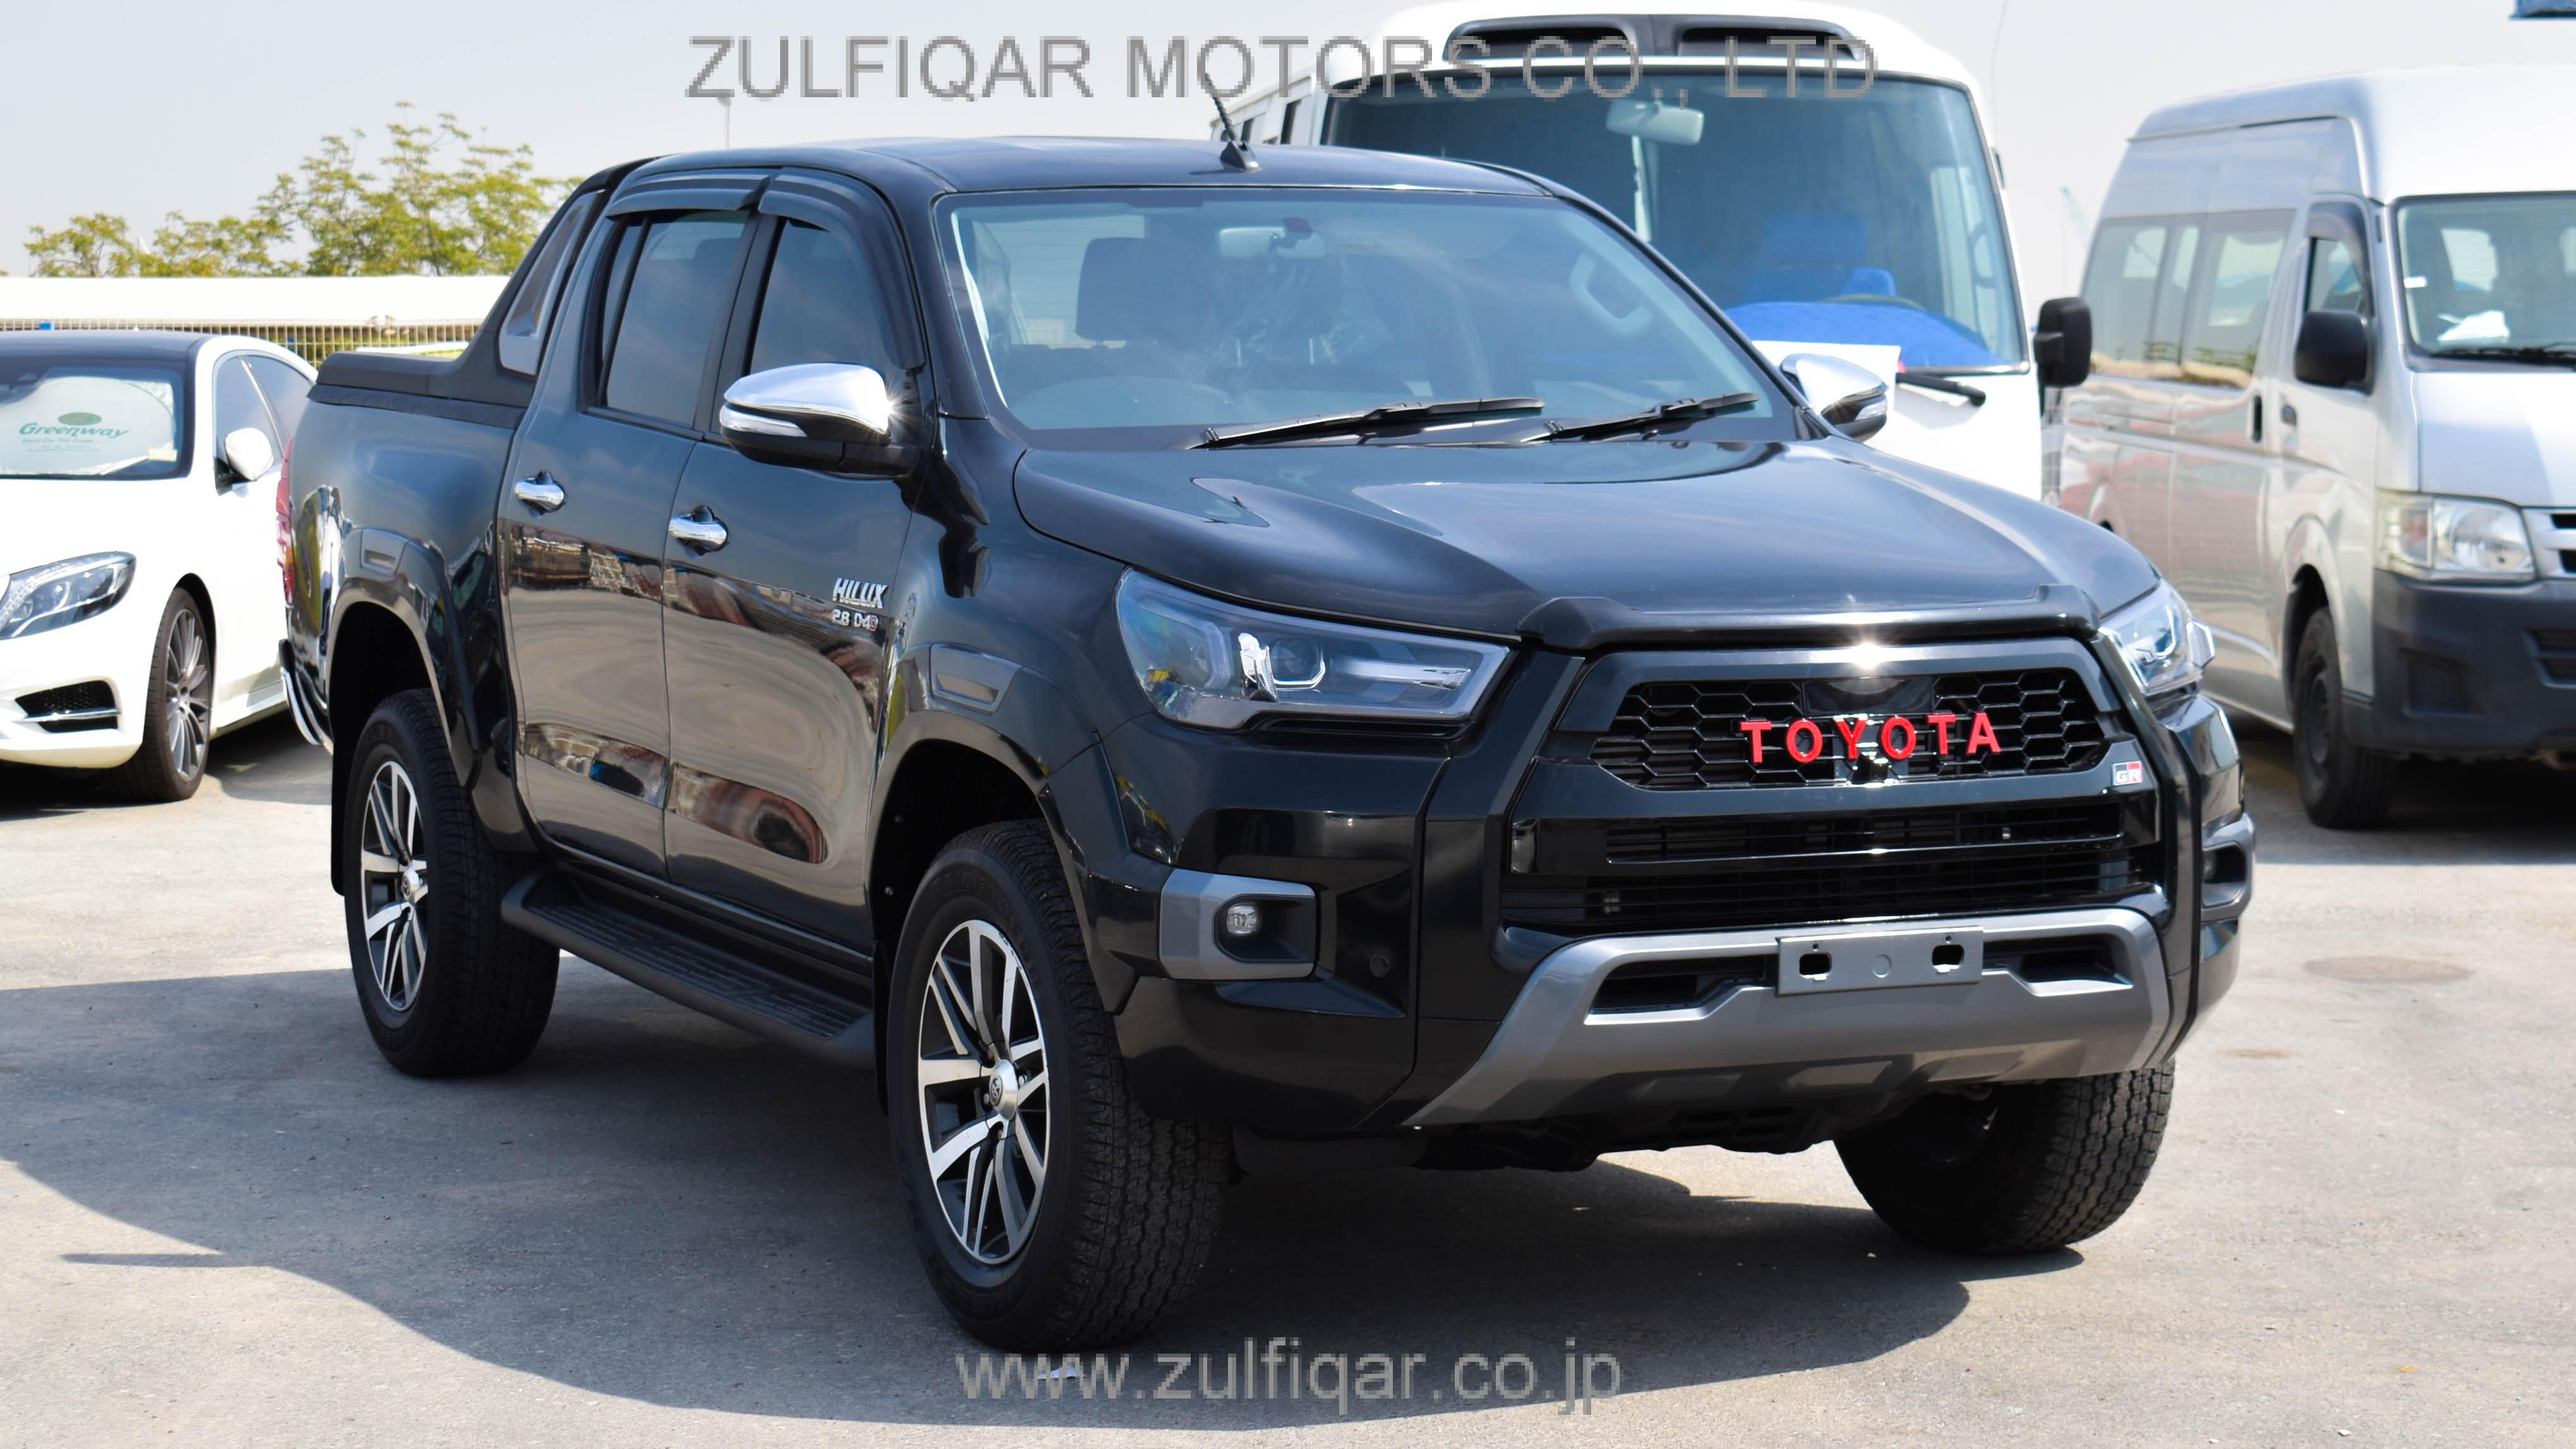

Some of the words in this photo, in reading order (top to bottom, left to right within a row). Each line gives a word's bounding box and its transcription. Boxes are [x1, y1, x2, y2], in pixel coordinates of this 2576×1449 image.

[19, 423, 129, 438] Greenway
[832, 577, 888, 609] HILUX
[1740, 712, 2001, 763] TOYOTA
[2115, 769, 2142, 784] GR
